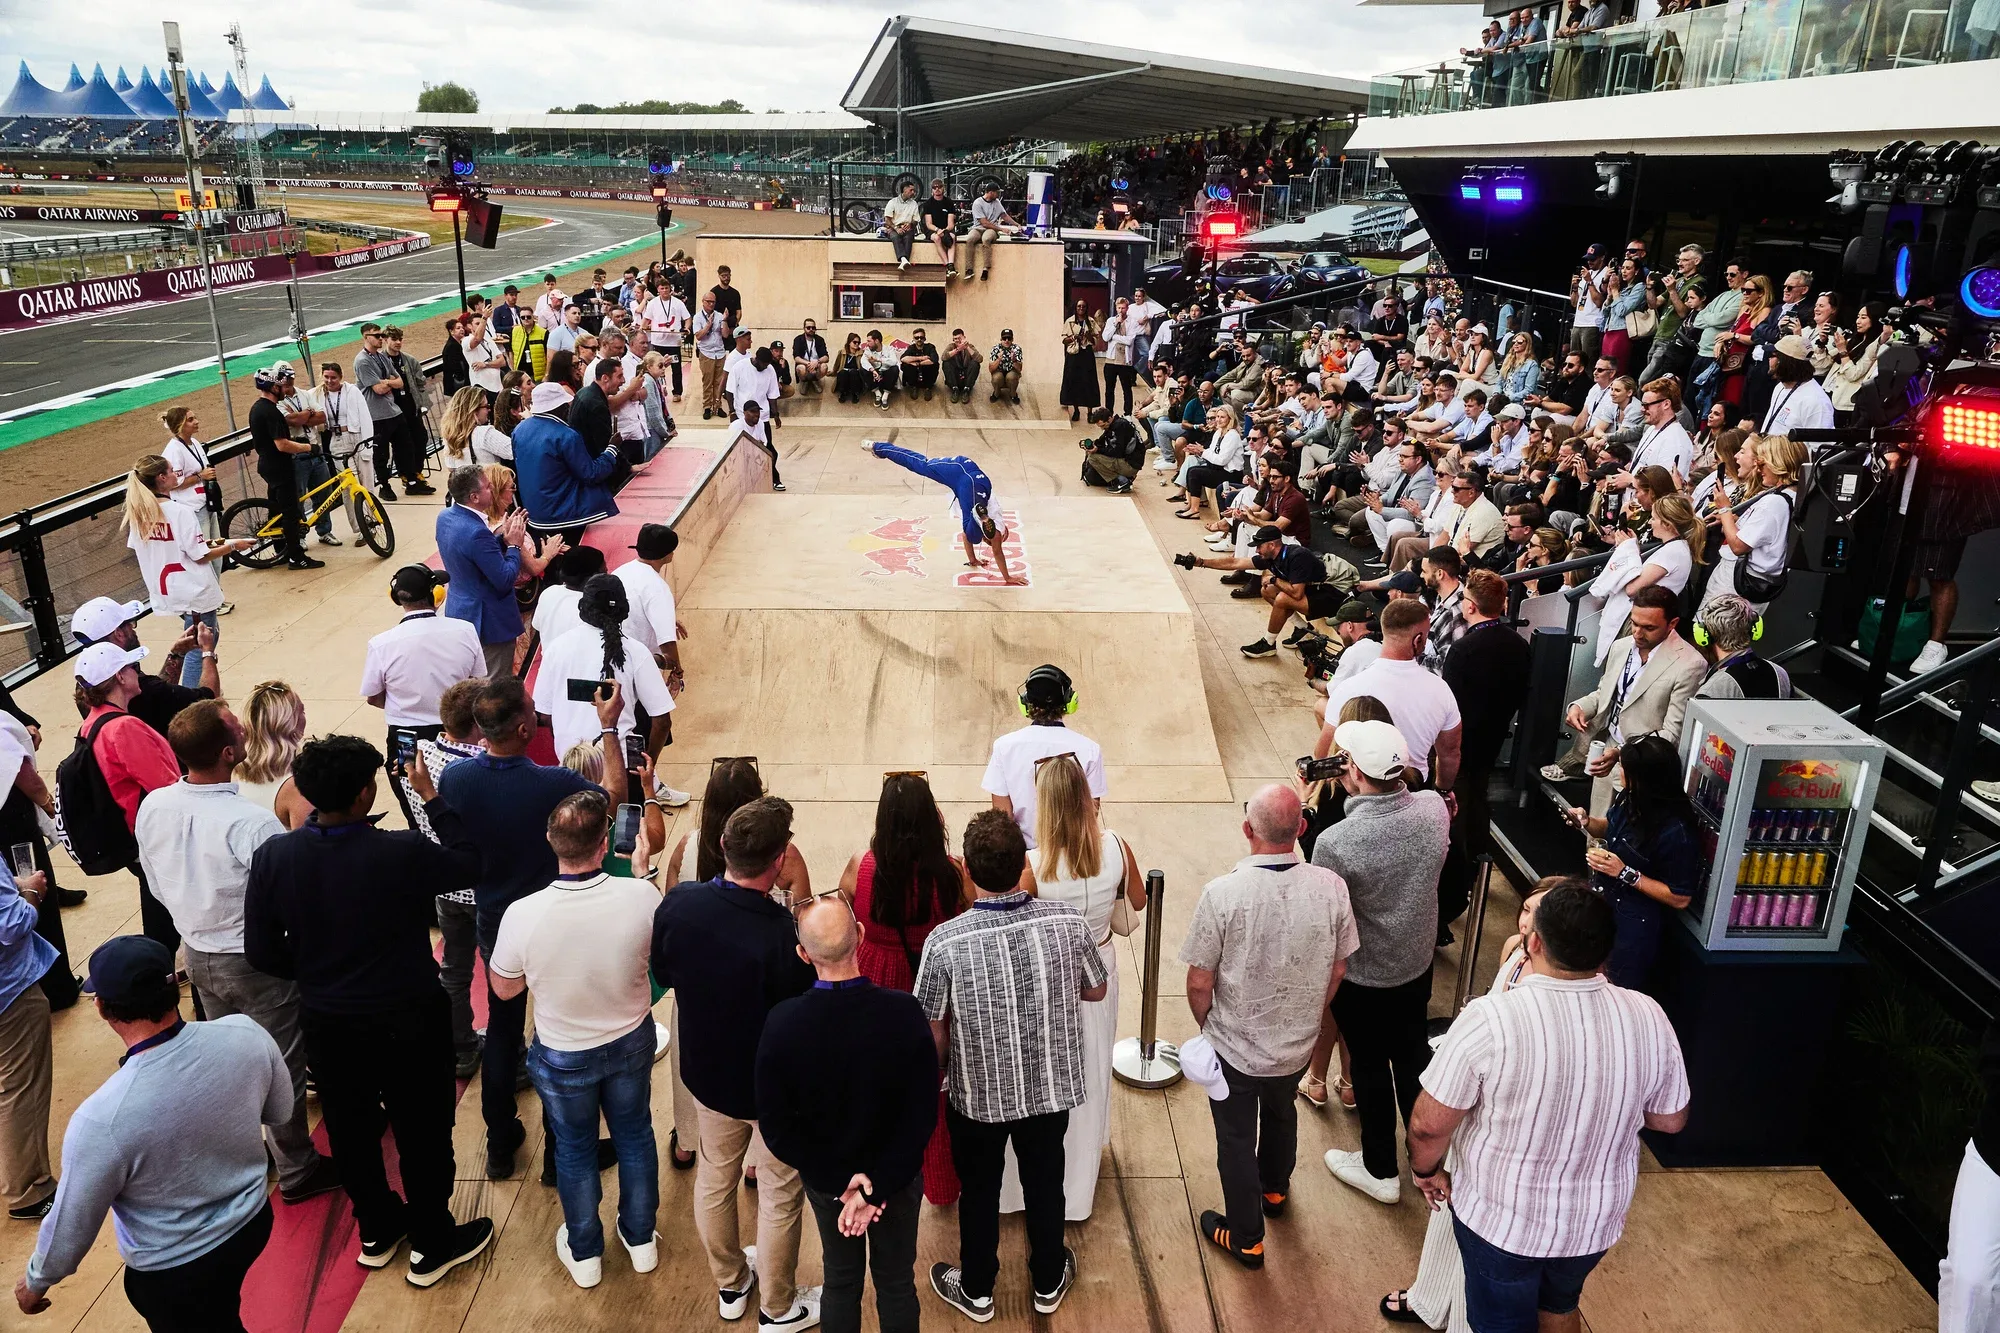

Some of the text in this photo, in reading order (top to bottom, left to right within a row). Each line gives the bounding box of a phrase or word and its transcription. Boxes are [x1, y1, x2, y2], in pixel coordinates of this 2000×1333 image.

[275, 179, 331, 188] QATAR AIRWAYS
[364, 183, 393, 191] AIRWAYS
[401, 184, 424, 192] QATAR
[536, 189, 562, 197] AIRWAYS
[569, 190, 611, 199] QATAR AIRWAYS
[617, 193, 654, 202] QATAR AIRWAYS
[678, 197, 700, 206] AIRWAYS
[707, 199, 749, 209] QATAR AIRWAYS
[38, 207, 139, 221] QATAR AIRWAYS
[236, 211, 282, 233] QATAR AIRWAYS
[374, 242, 405, 260] QATAR AIRWAYS
[407, 239, 420, 252] QATAR
[334, 251, 370, 269] QATAR AIRWAYS
[167, 261, 255, 294] QATAR AIRWAYS
[18, 286, 78, 319] QATAR
[80, 277, 142, 307] AIRWAYS
[1768, 782, 1842, 799] Red Bull
